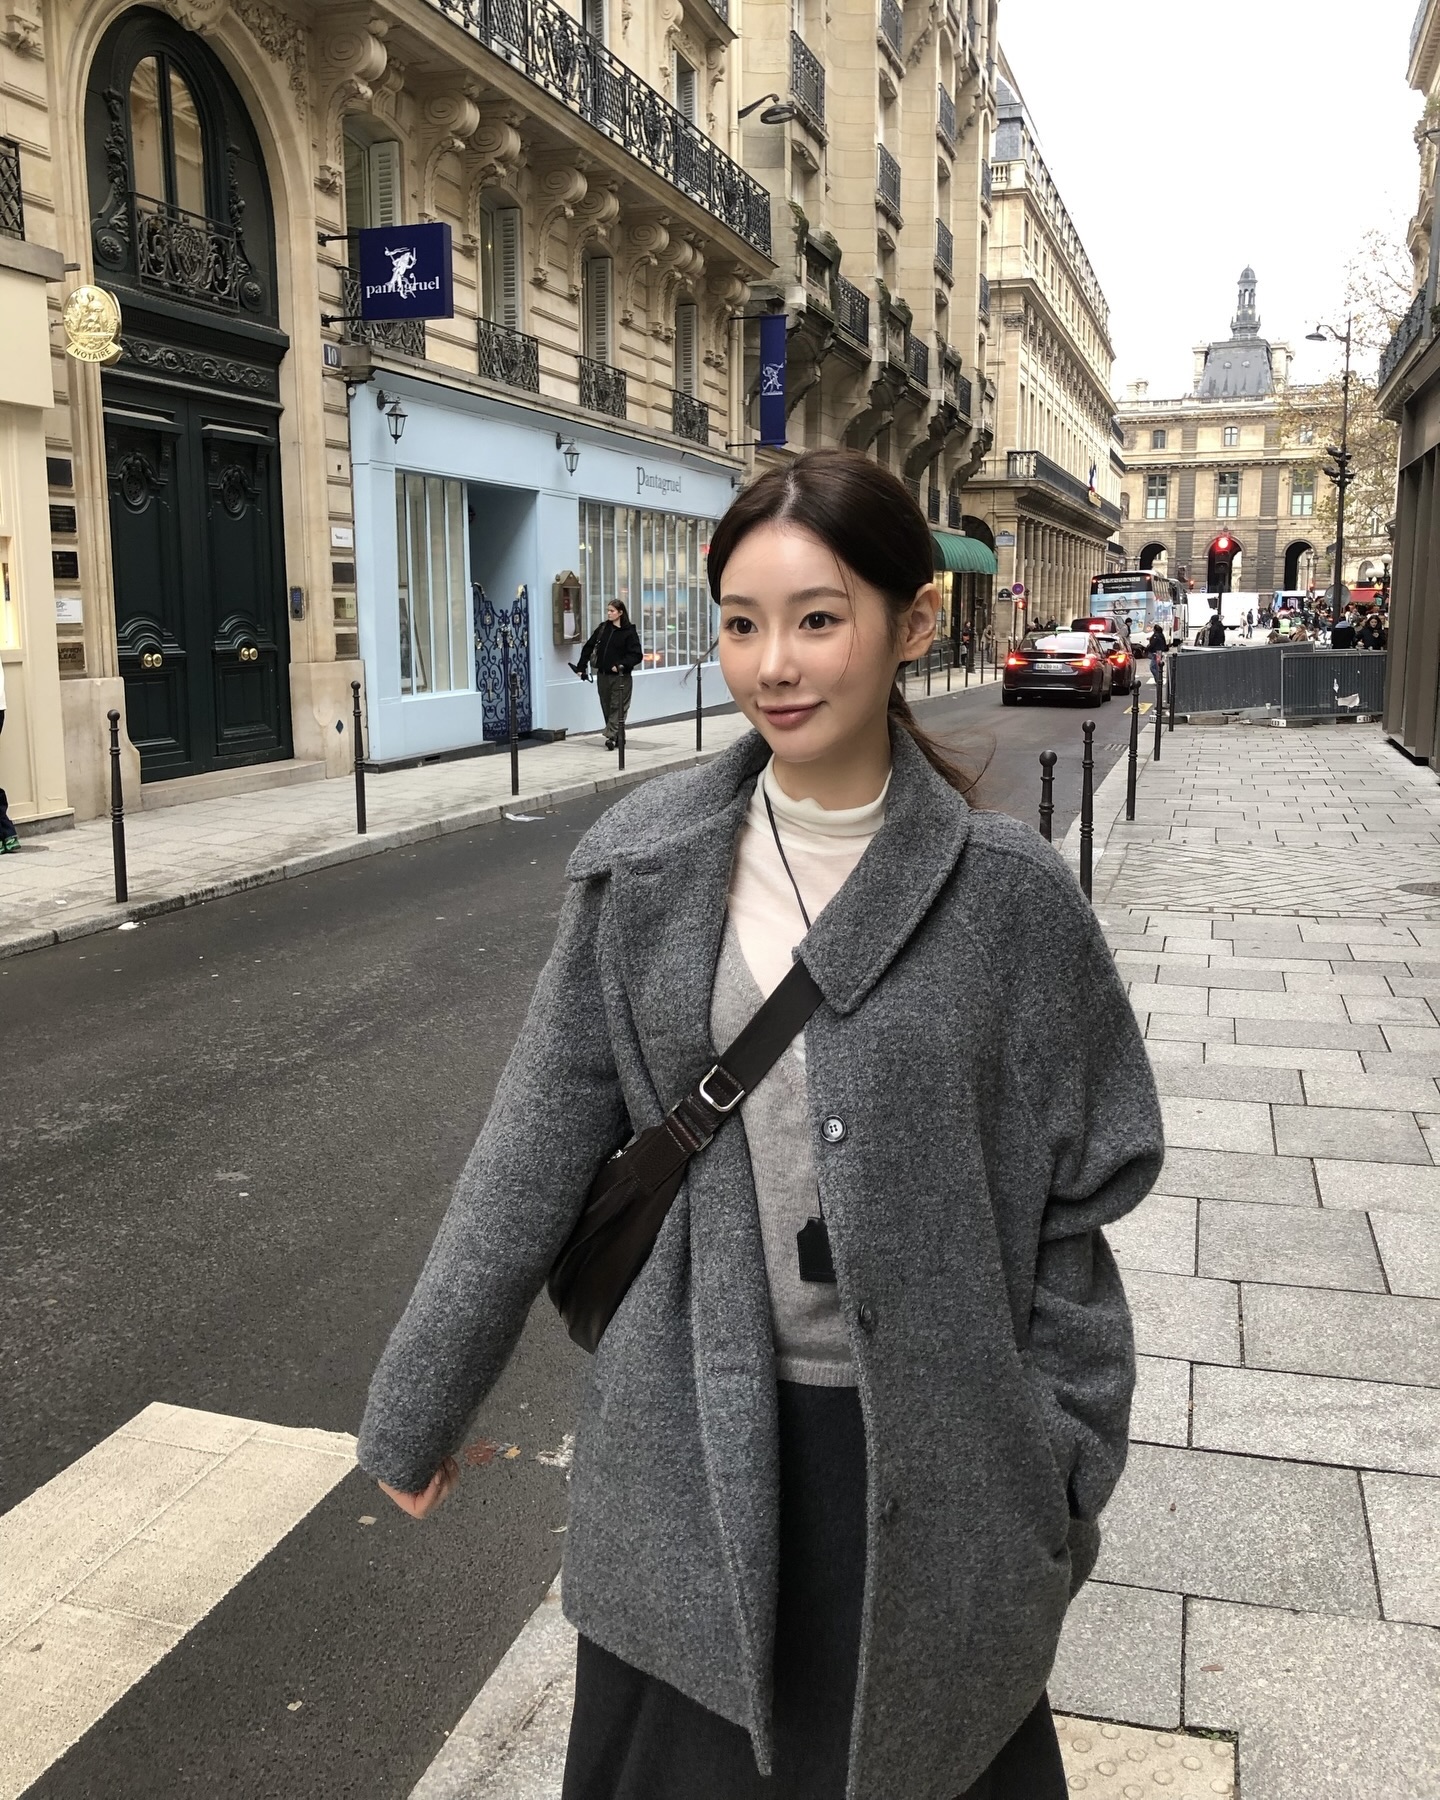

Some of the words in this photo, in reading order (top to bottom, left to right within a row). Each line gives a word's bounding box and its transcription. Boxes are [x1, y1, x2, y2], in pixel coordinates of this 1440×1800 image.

[366, 276, 440, 298] pantagruel
[73, 348, 112, 360] NOTAIRE
[327, 346, 338, 365] 10
[636, 466, 682, 496] Pantagruel
